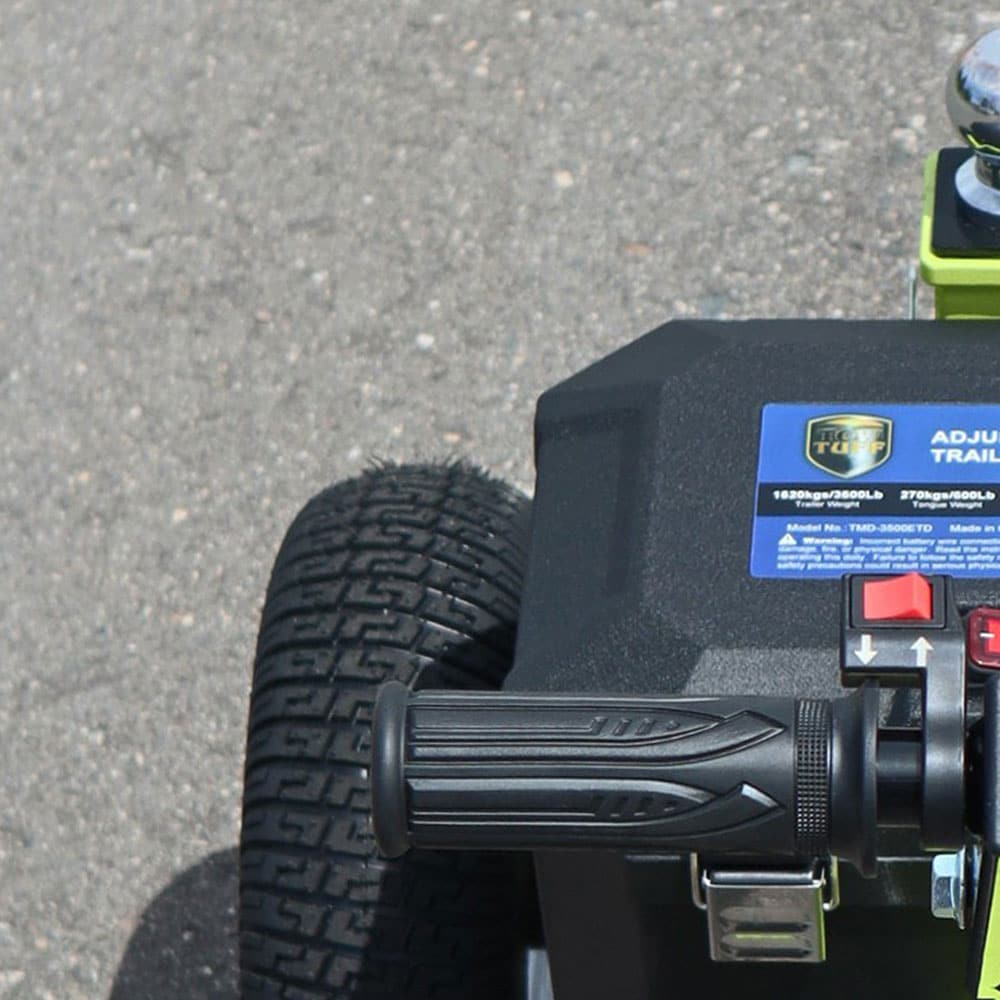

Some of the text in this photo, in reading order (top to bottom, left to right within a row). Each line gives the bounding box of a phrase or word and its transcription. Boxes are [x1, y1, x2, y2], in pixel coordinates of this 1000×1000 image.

[827, 501, 860, 509] Weight
[912, 501, 983, 509] Tongue Weight
[787, 523, 822, 532] Model
[949, 524, 982, 533] Made
[984, 524, 995, 533] in
